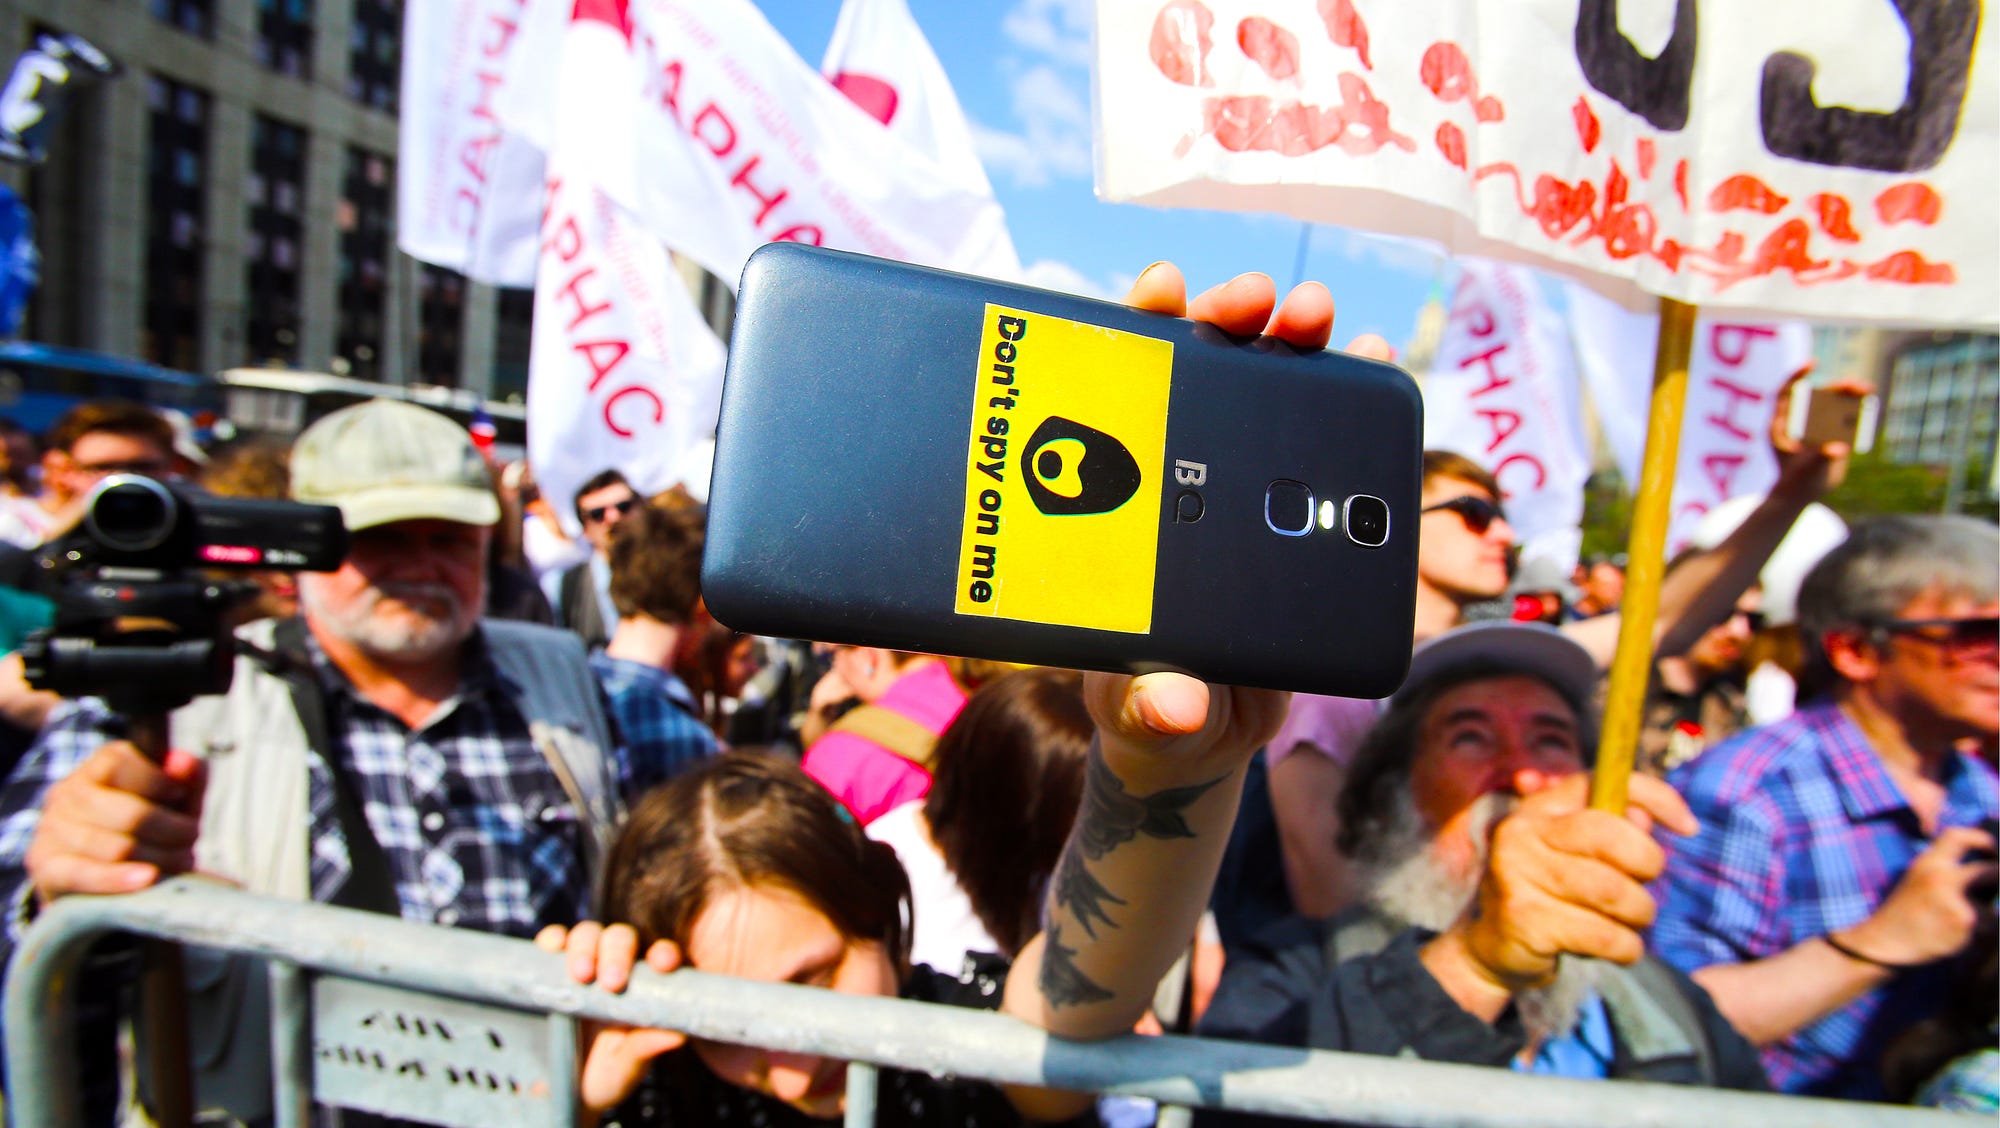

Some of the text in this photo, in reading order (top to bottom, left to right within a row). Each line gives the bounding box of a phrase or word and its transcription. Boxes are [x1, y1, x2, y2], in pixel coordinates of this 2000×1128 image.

[969, 314, 1027, 603] Don't spy on me
[1174, 458, 1207, 525] BQ
